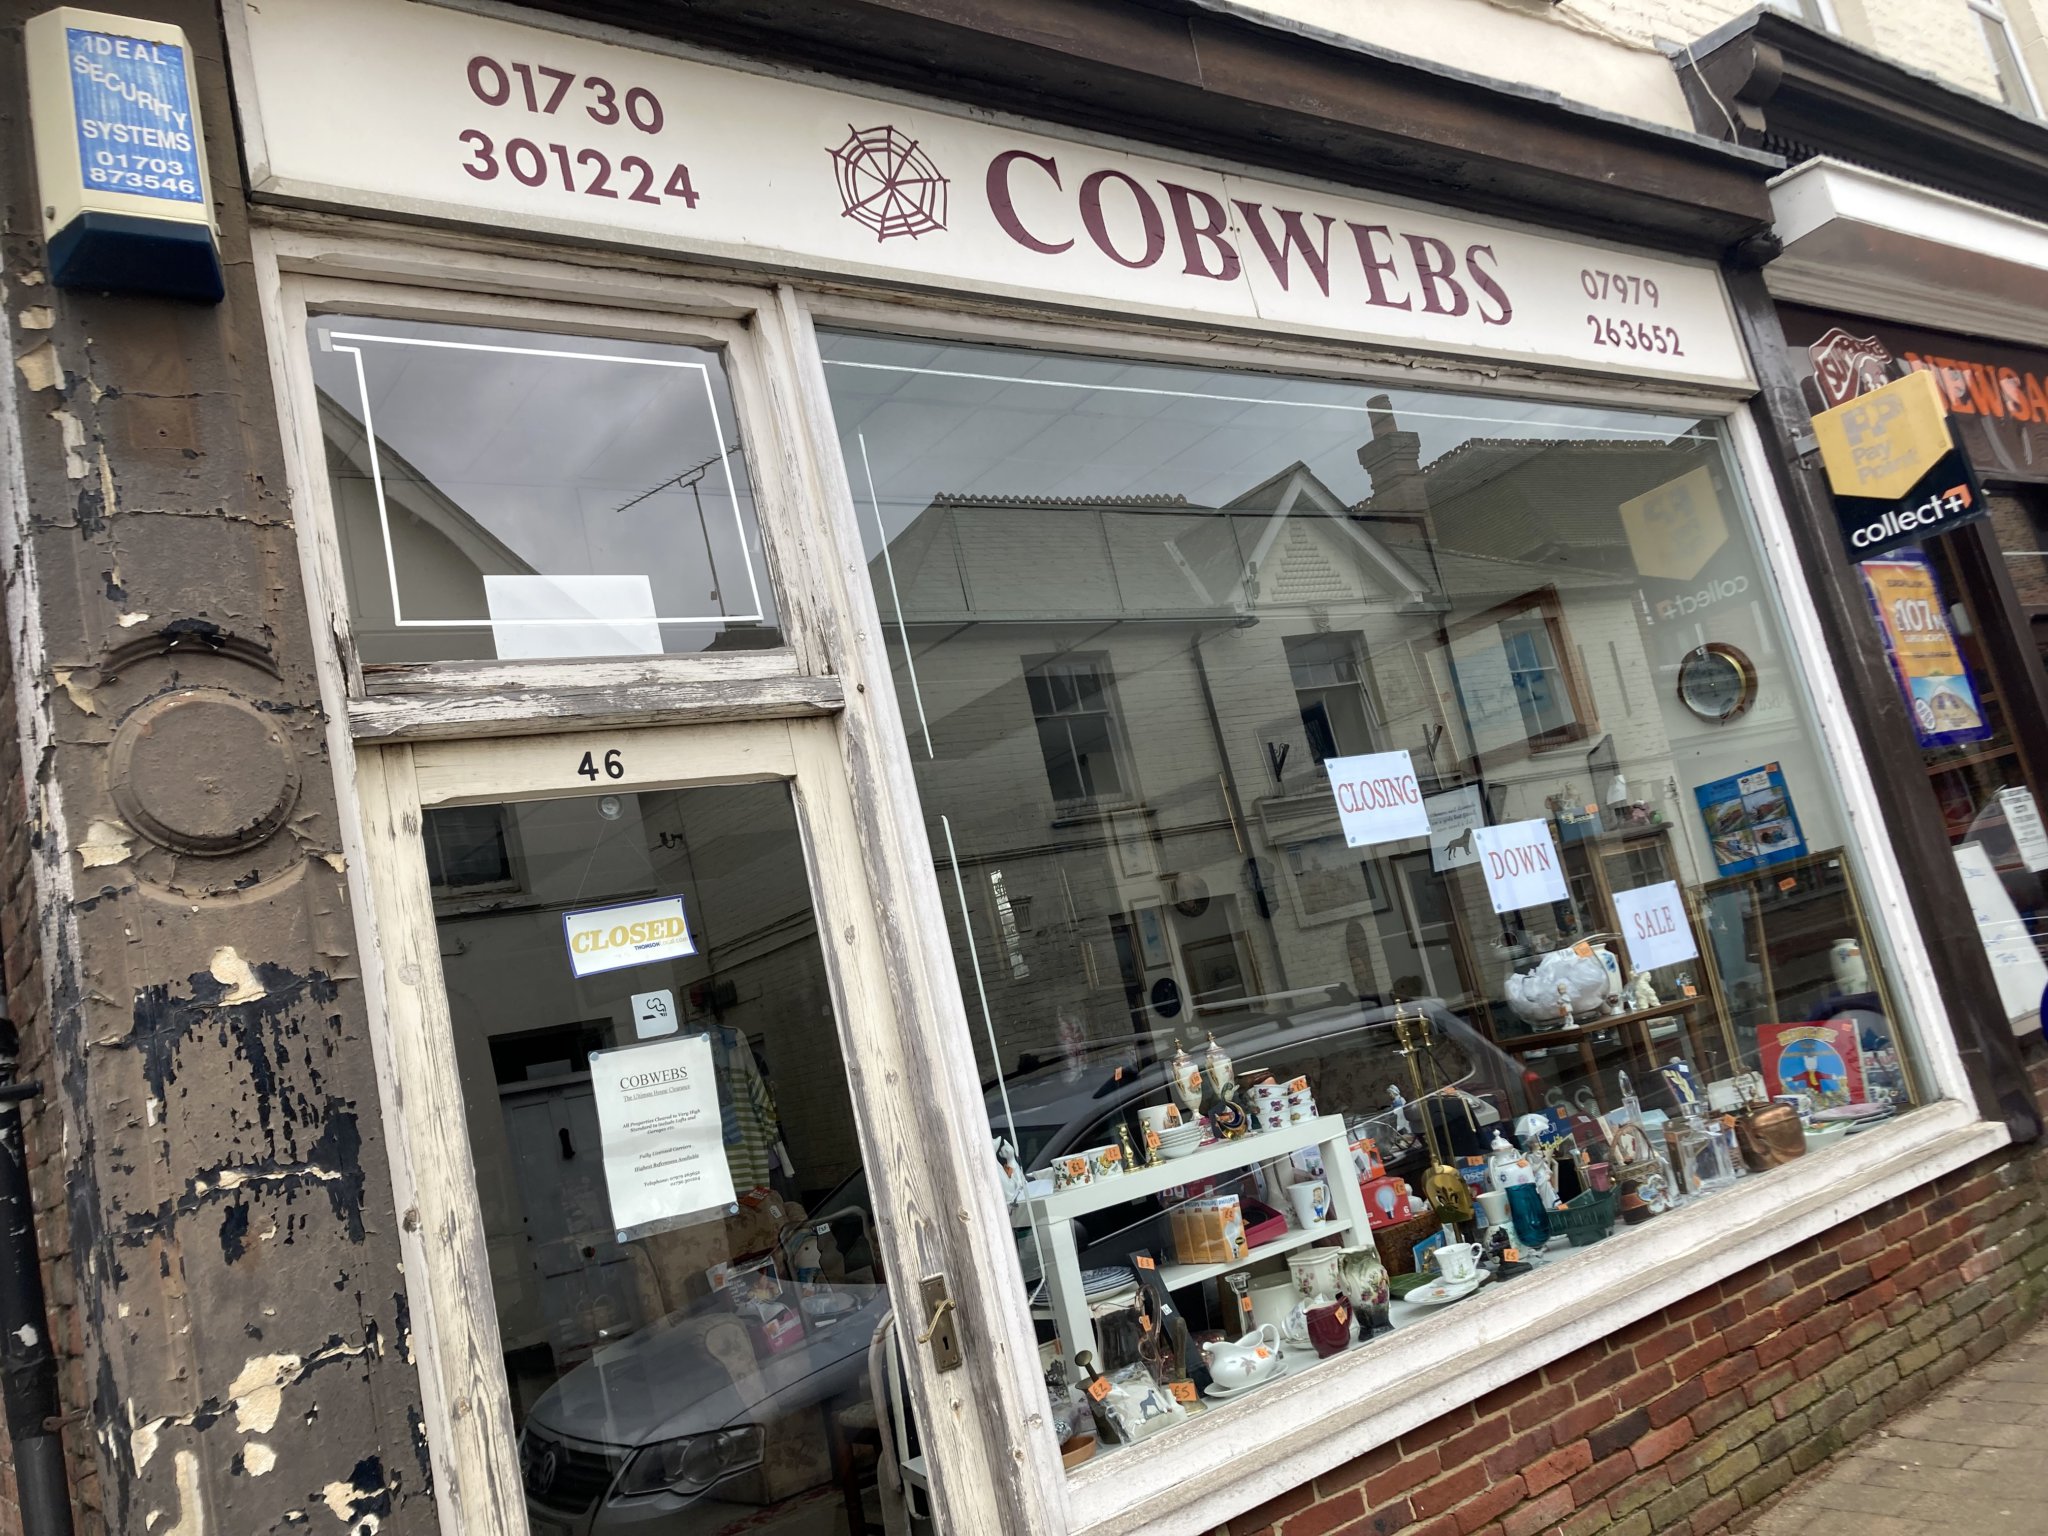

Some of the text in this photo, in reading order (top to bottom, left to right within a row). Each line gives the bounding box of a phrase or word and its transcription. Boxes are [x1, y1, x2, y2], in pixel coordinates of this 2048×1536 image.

[82, 35, 168, 65] IDEAL
[73, 55, 187, 130] SECURITY
[466, 55, 664, 135] 01730
[82, 119, 192, 152] SYSTEMS
[89, 167, 195, 194] 873546
[96, 151, 185, 176] 01703
[458, 128, 701, 209] 301224
[985, 149, 1513, 327] COBWEBS
[1580, 269, 1659, 308] 07979
[1586, 314, 1685, 357] 263652
[1851, 442, 1893, 466] Pay
[577, 749, 625, 781] 46
[1338, 774, 1418, 814] CLOSING
[1488, 842, 1551, 881] DOWN
[571, 916, 685, 954] CLOSED
[1633, 904, 1676, 940] SALE
[620, 1066, 688, 1090] COBWEBS
[1092, 1382, 1108, 1398] £2
[1173, 1387, 1191, 1399] £5
